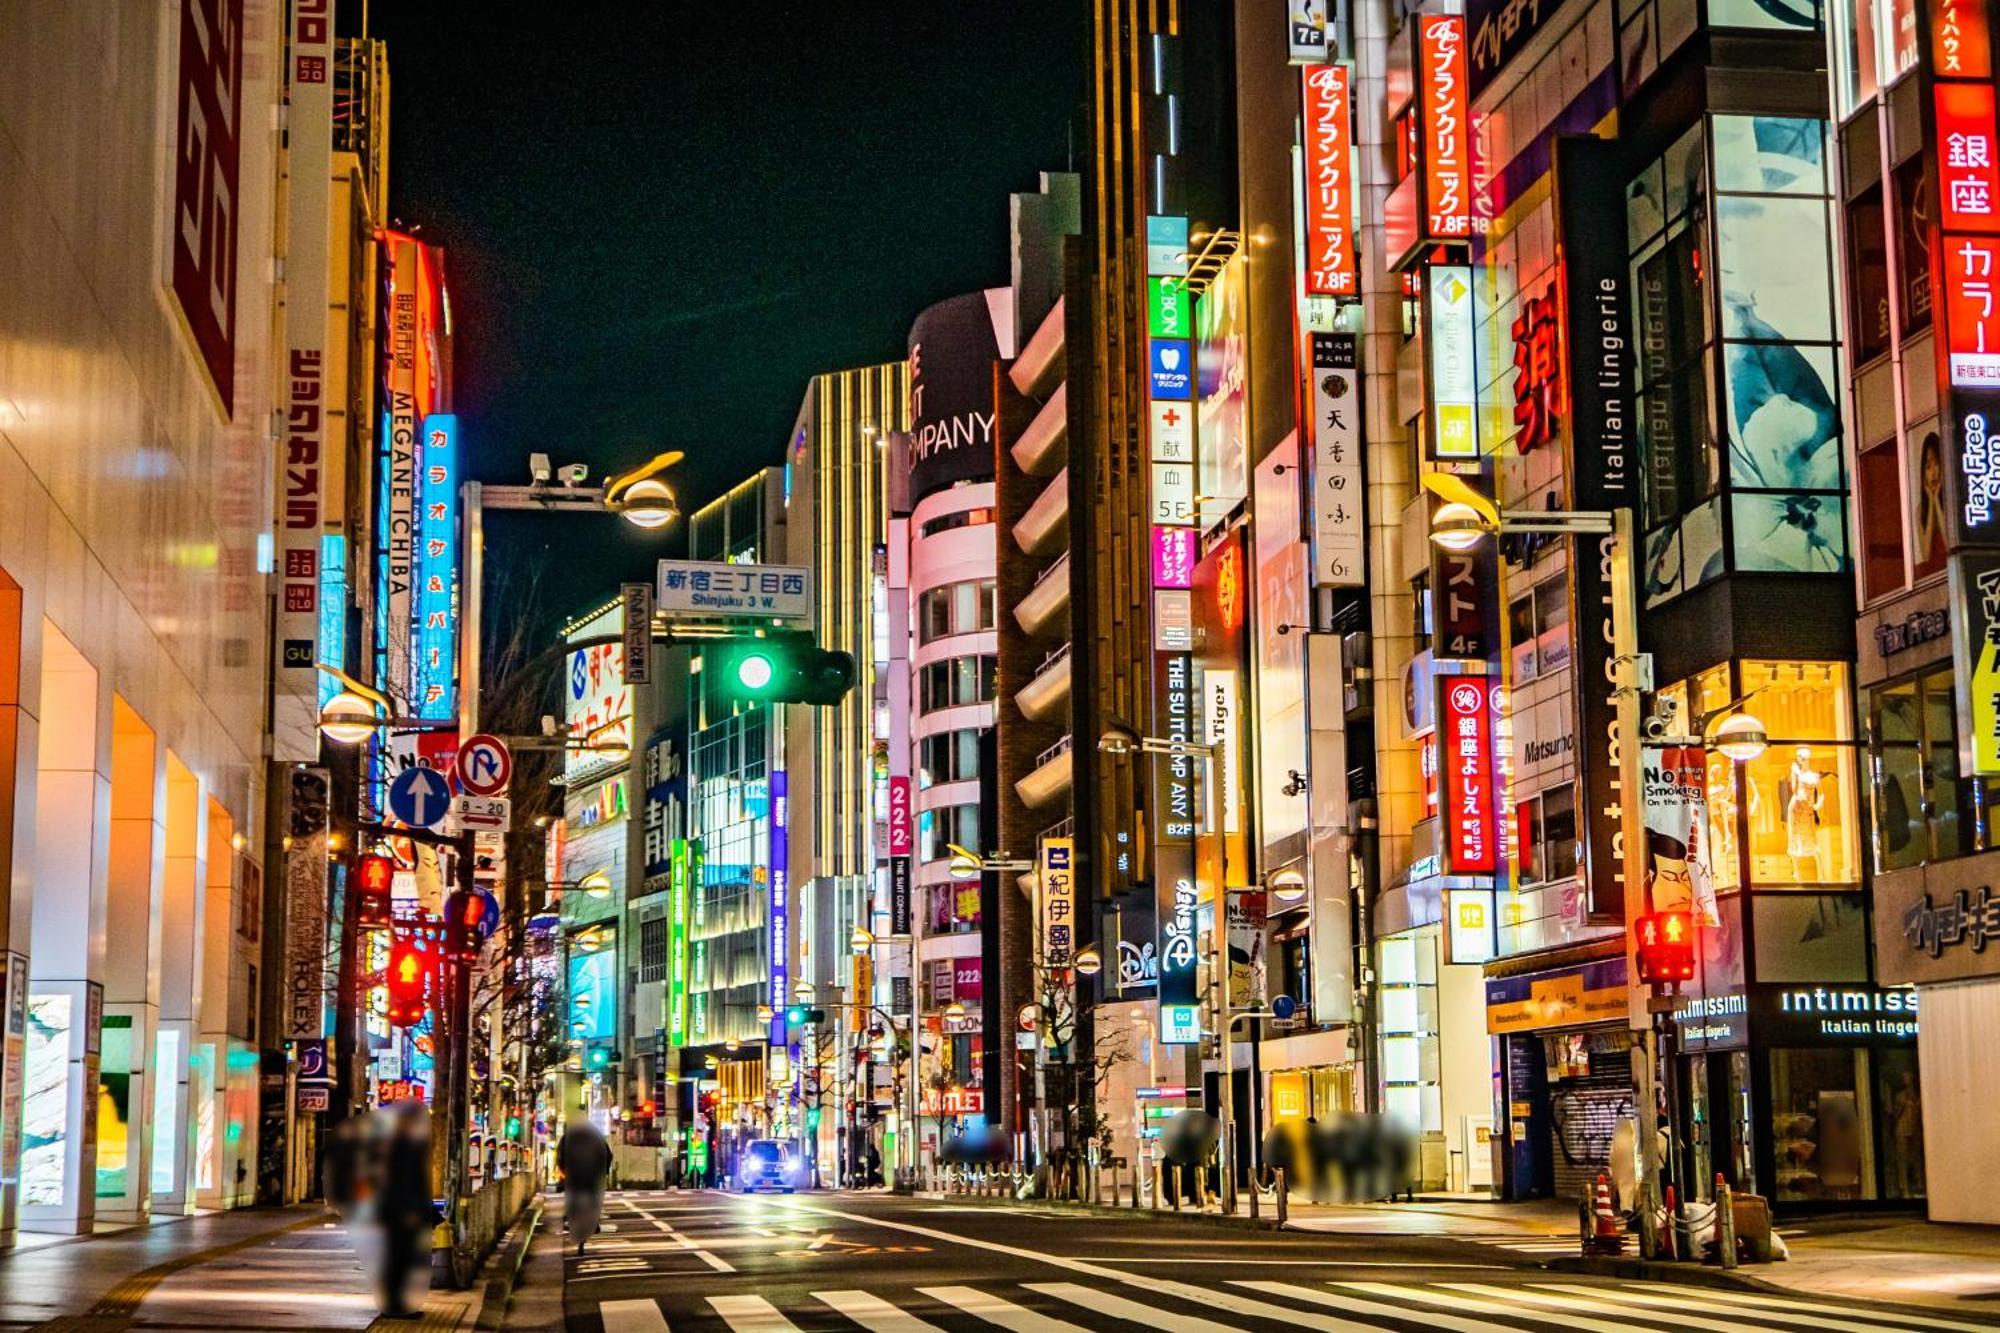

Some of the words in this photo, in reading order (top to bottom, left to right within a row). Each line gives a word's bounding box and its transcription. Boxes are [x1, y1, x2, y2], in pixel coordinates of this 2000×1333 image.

[1297, 27, 1320, 42] 7F
[1434, 53, 1460, 215] ブランクリニック
[1317, 101, 1342, 271] ブランクリニック
[1431, 216, 1469, 232] 7.8F
[1313, 271, 1352, 289] 7.8F
[1596, 278, 1624, 389] lingerie
[391, 391, 412, 497] MEGANE
[1163, 440, 1180, 485] 献血
[1602, 399, 1625, 490] Italian
[1966, 414, 1985, 473] Free
[1967, 478, 1985, 525] Tax
[390, 511, 410, 596] ICHIBA
[666, 569, 804, 594] 新宿三丁目西
[691, 594, 743, 607] Shinjuku
[747, 596, 756, 607] 3
[1448, 556, 1475, 622] スト
[1450, 635, 1478, 654] 4F
[1875, 622, 1905, 657] Tax
[1906, 607, 1945, 642] Free
[286, 648, 313, 662] GU
[1168, 656, 1185, 689] THE
[1169, 691, 1186, 732] SUIT
[1212, 684, 1229, 739] Tiger
[1458, 717, 1481, 815] 銀座よしえ
[1643, 767, 1675, 784] No
[1646, 785, 1701, 798] Smoking
[1167, 824, 1192, 835] B2F
[293, 961, 310, 1036] ROLEX
[1821, 1019, 1871, 1033] Italian
